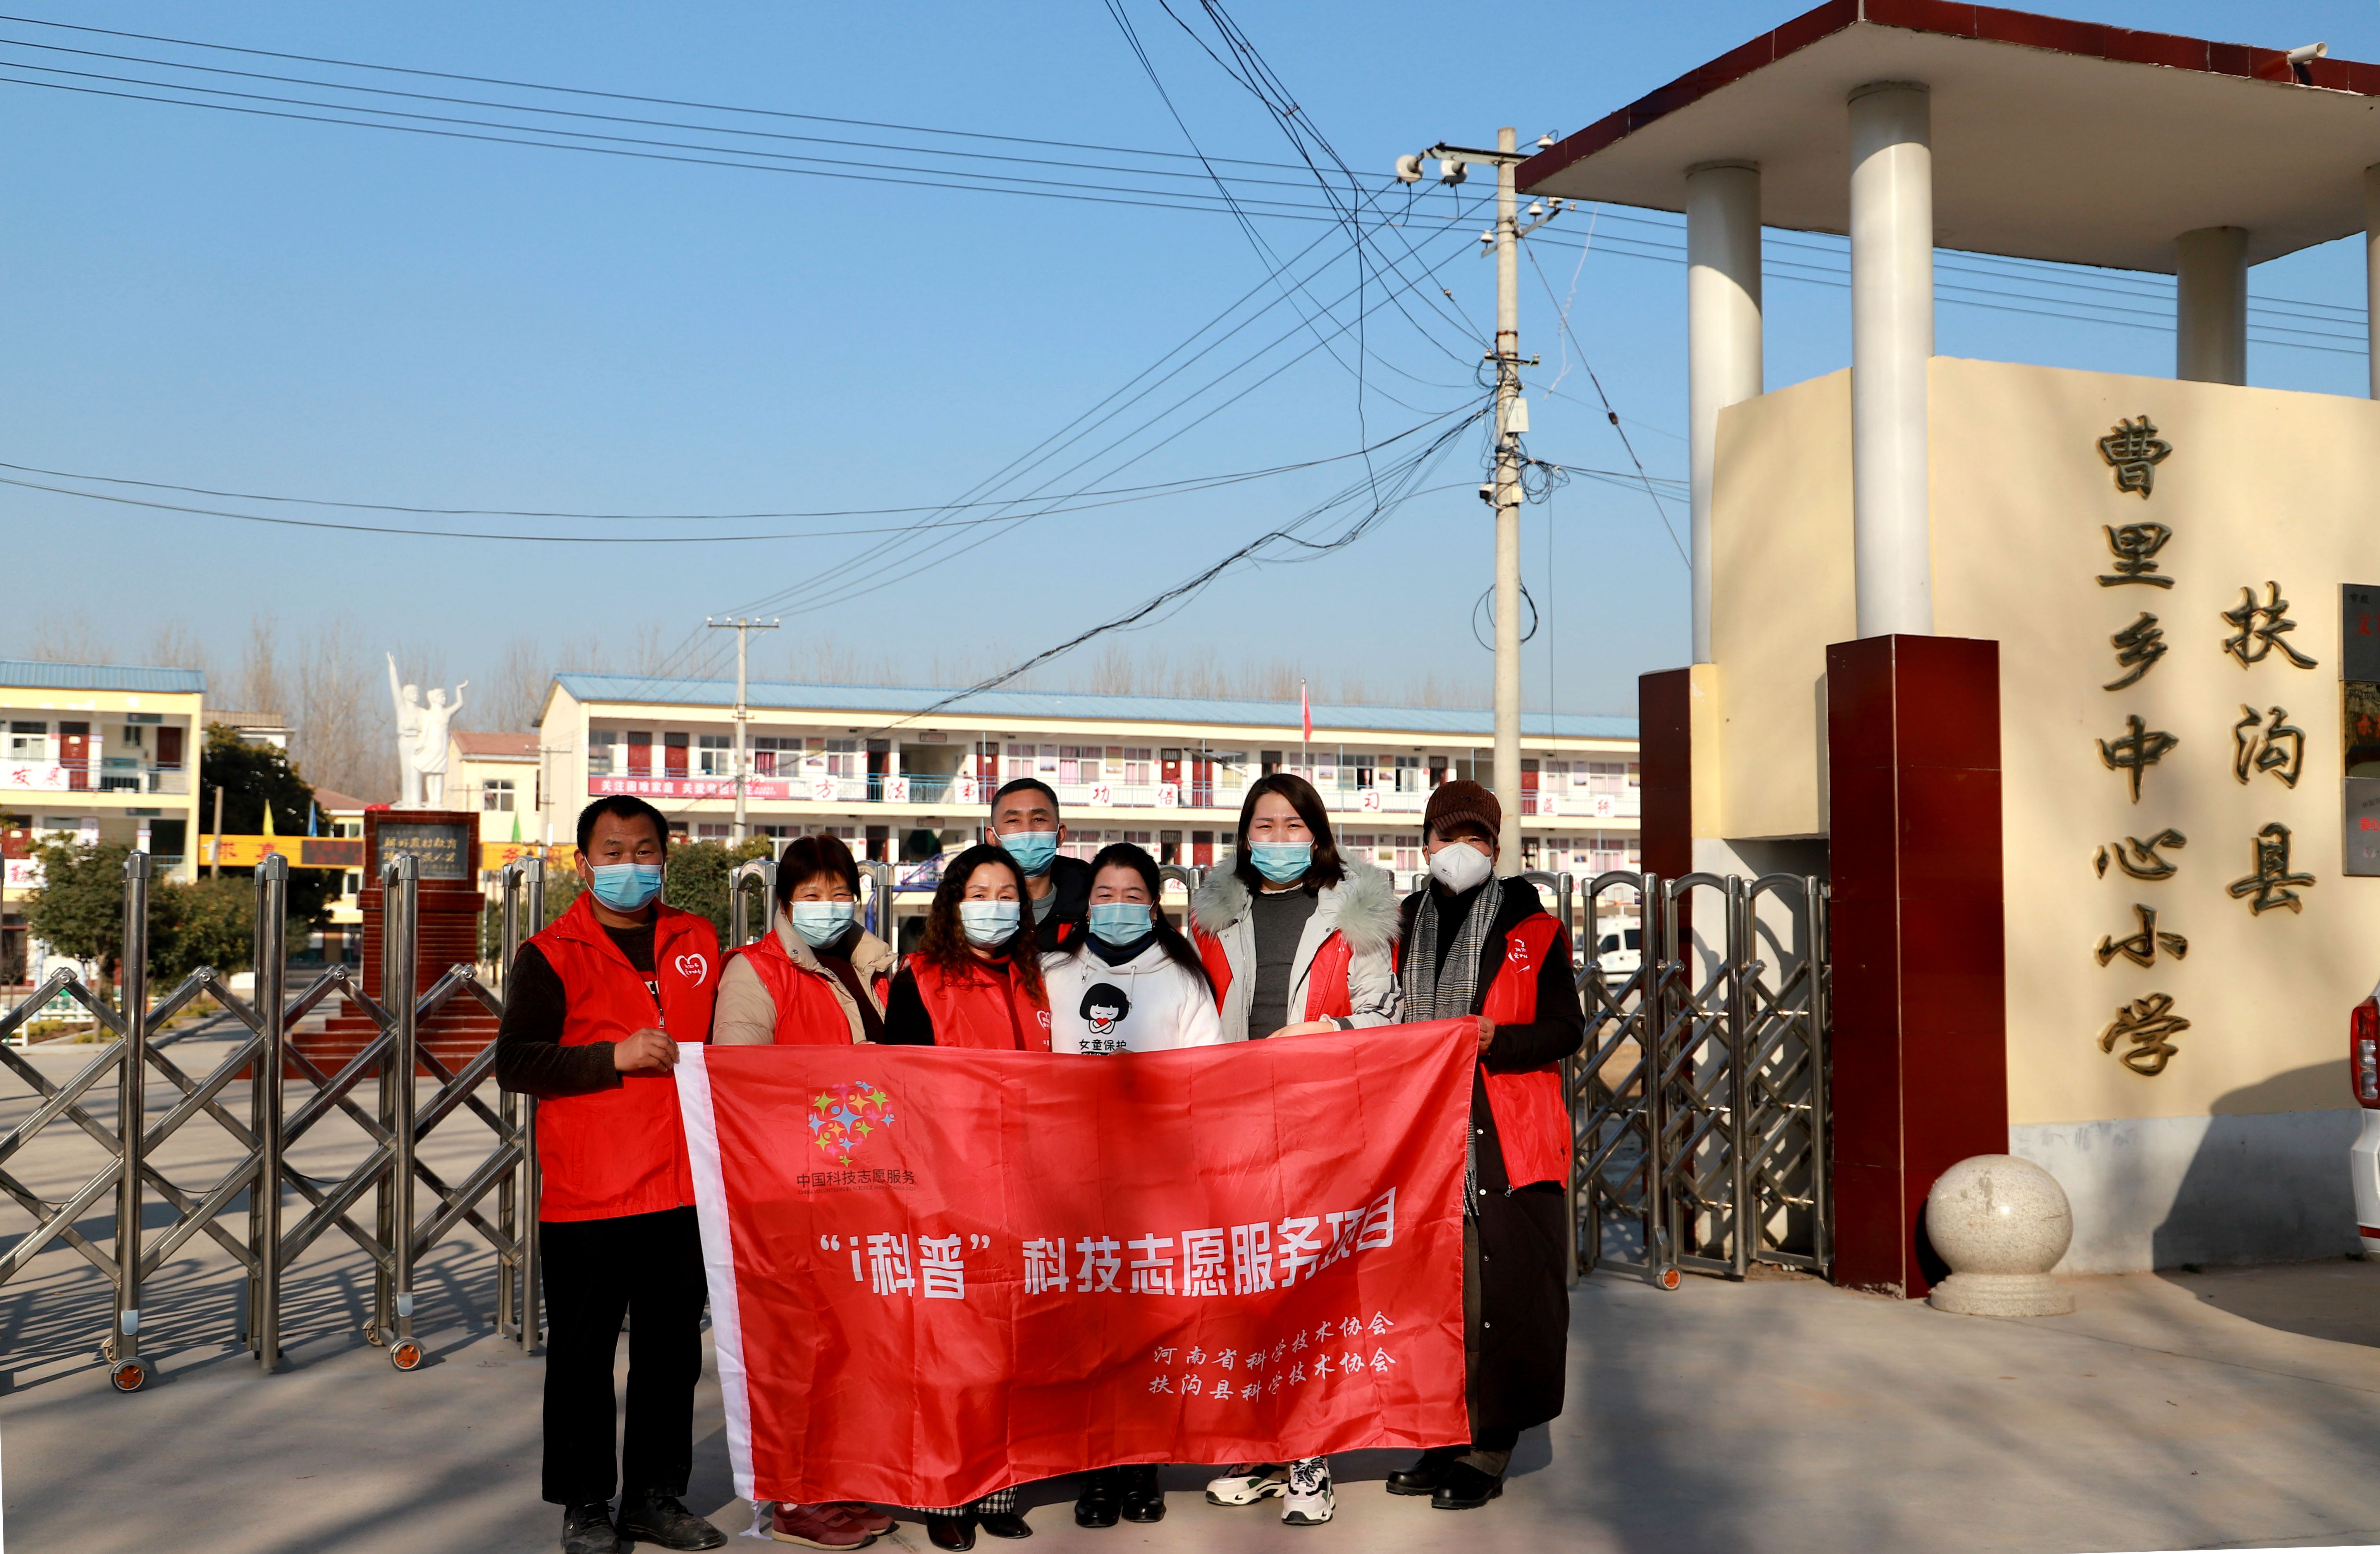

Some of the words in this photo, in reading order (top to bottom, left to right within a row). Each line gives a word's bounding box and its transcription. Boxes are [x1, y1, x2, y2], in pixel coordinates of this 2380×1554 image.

[2355, 611, 2380, 635] 文
[2092, 414, 2191, 1076] 曹里乡中心小学
[2221, 581, 2319, 916] 扶沟县
[602, 779, 674, 794] 关注困难家庭
[1364, 792, 1380, 810] 习
[1079, 1039, 1127, 1051] 女童保护
[797, 1169, 915, 1188] 中国科技志愿服务
[820, 1232, 991, 1300] “i科普”
[1022, 1186, 1397, 1297] 科技志愿服务项目
[1154, 1310, 1395, 1372] 河南省科学技术协会
[1149, 1346, 1396, 1403] 扶沟县科学技术协会
